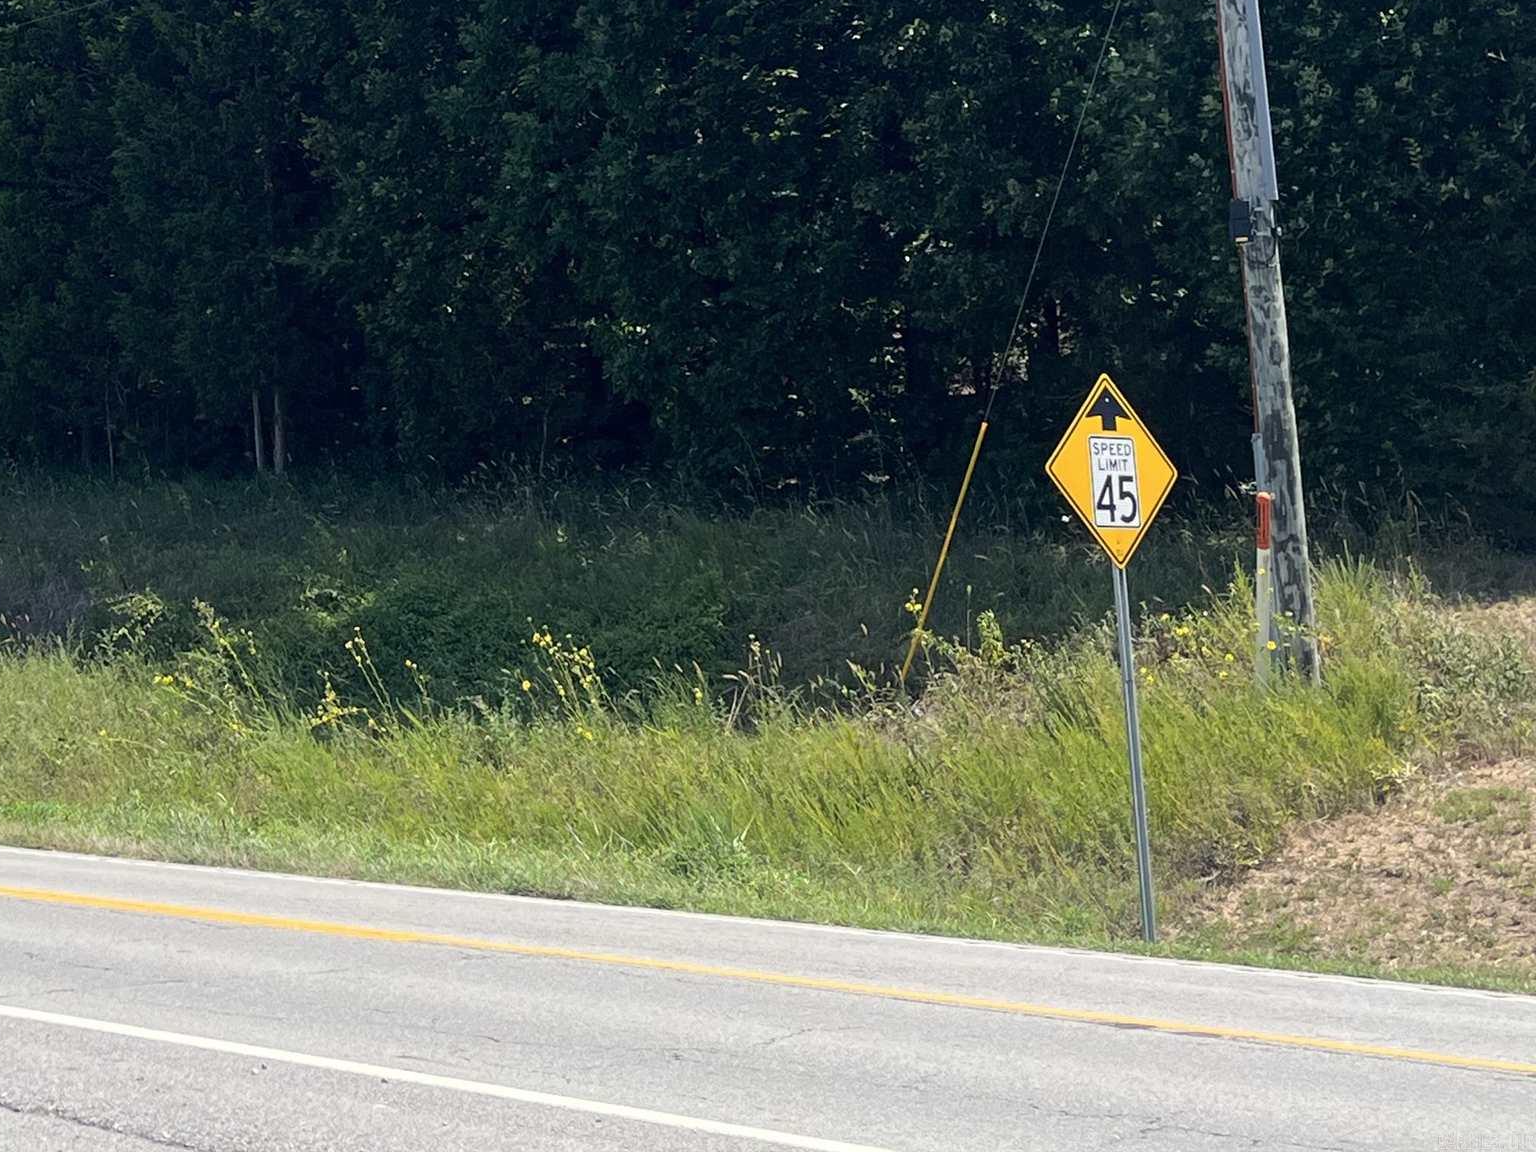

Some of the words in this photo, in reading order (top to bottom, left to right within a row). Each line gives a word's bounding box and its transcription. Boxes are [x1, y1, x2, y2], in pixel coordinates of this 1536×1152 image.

[1093, 442, 1131, 456] SPEED
[1098, 459, 1128, 471] LIMIT
[1096, 475, 1137, 523] 45
